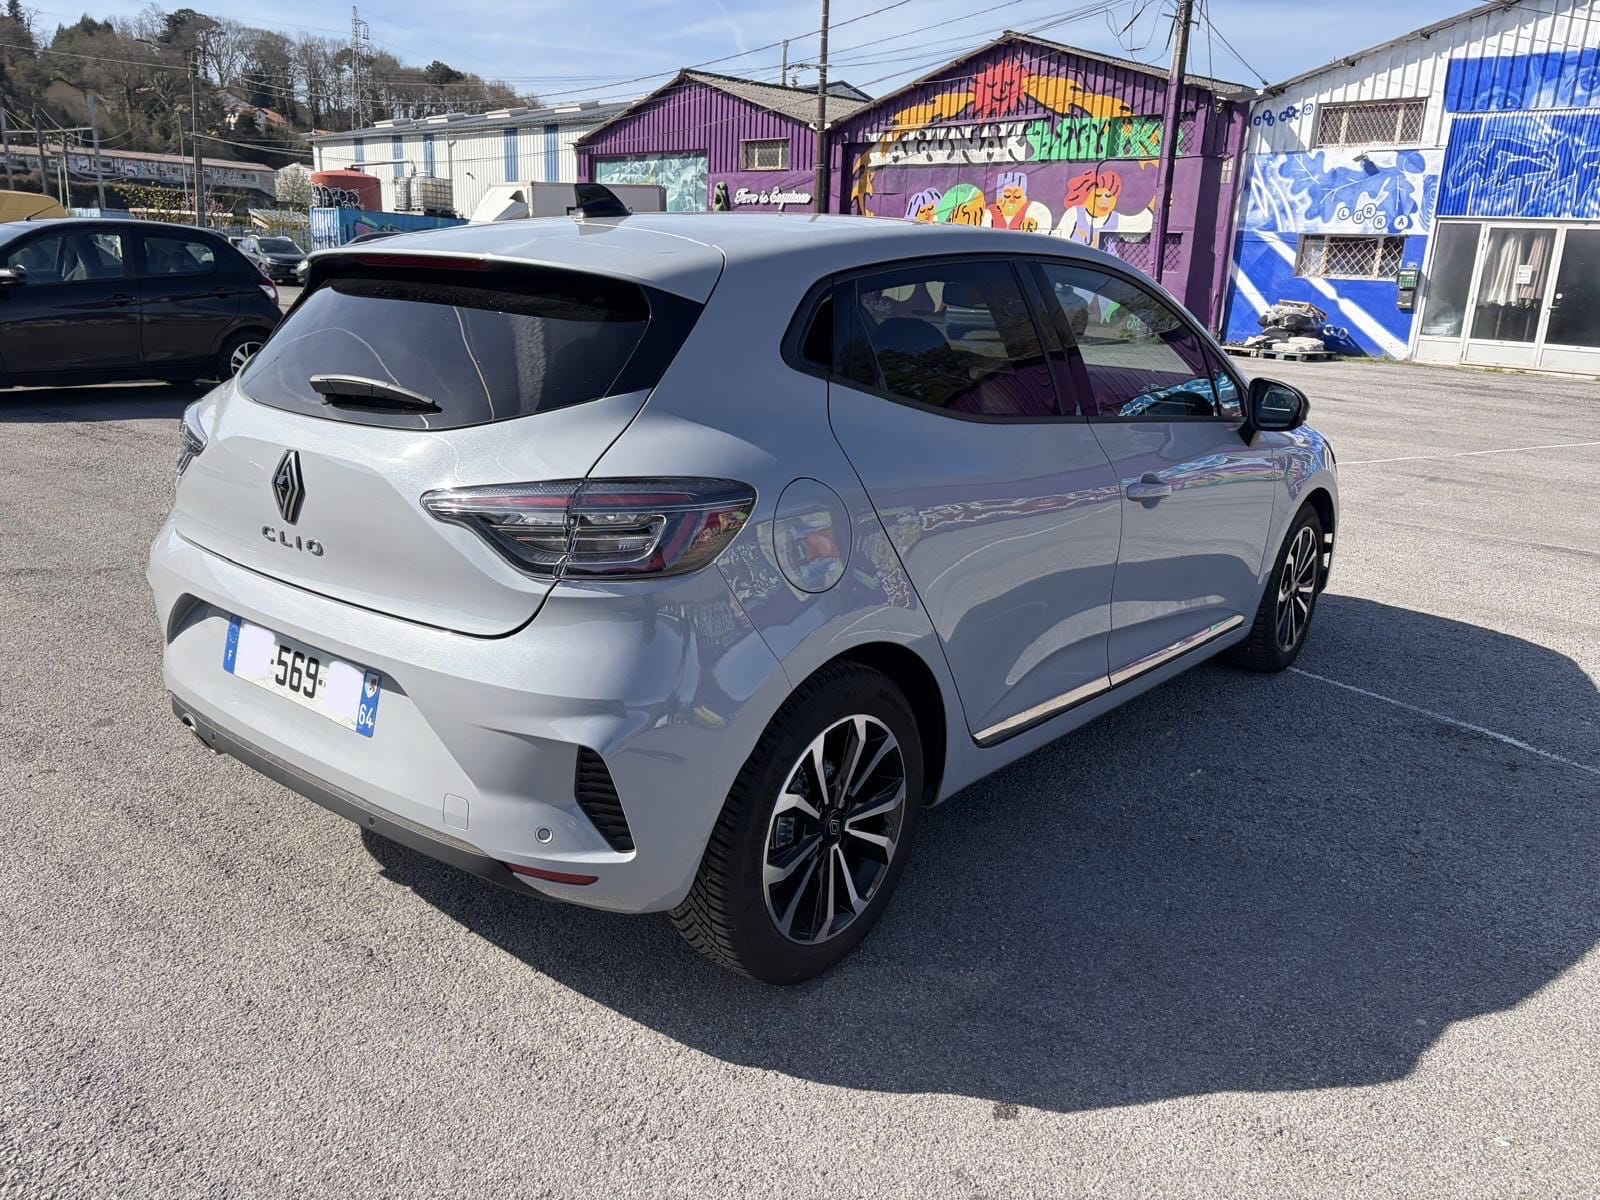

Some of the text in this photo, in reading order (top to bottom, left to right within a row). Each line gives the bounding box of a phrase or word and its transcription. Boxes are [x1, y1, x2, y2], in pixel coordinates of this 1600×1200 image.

[262, 525, 325, 557] CLIO
[227, 650, 233, 660] F
[359, 703, 374, 728] 64
